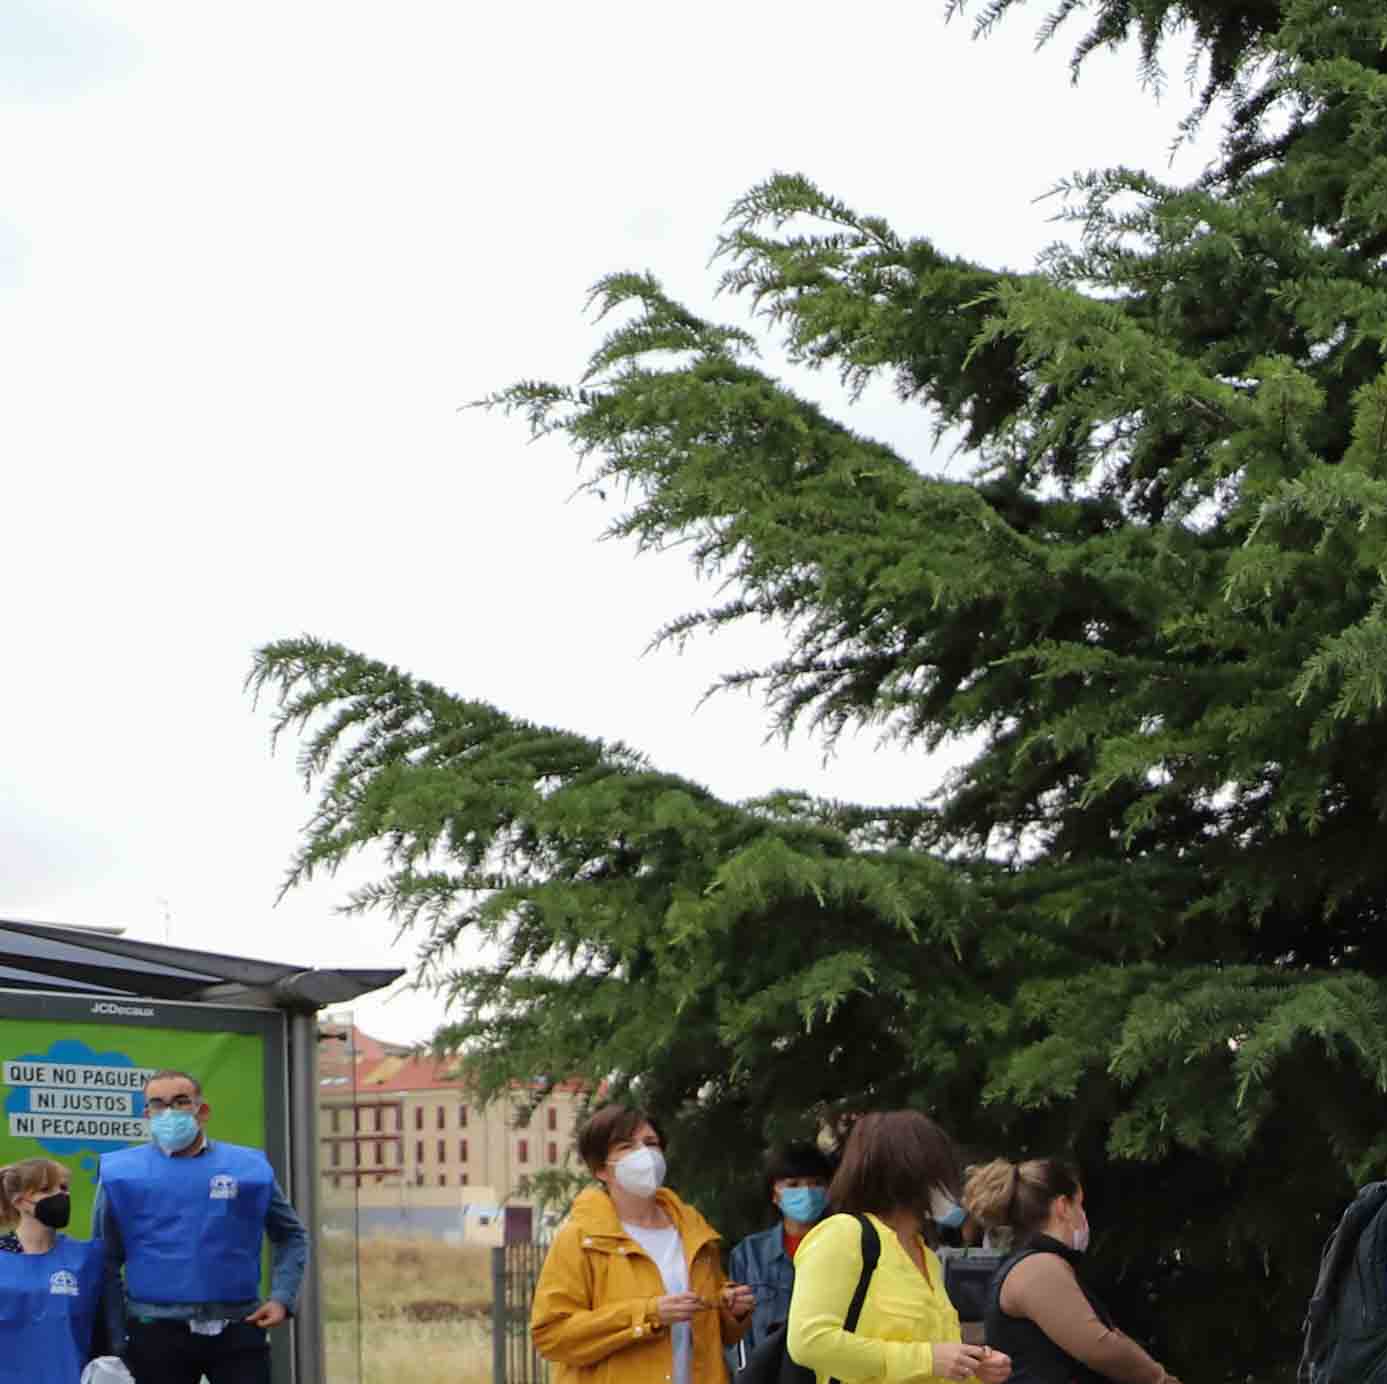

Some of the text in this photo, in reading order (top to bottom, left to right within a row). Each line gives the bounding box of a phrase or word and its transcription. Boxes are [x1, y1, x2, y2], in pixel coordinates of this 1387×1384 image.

[91, 1003, 154, 1016] JCDecaux
[10, 1066, 46, 1082] QUE
[53, 1068, 77, 1084] NO
[37, 1094, 127, 1112] NI JUSTOS
[16, 1118, 149, 1137] NI PECADORES.
